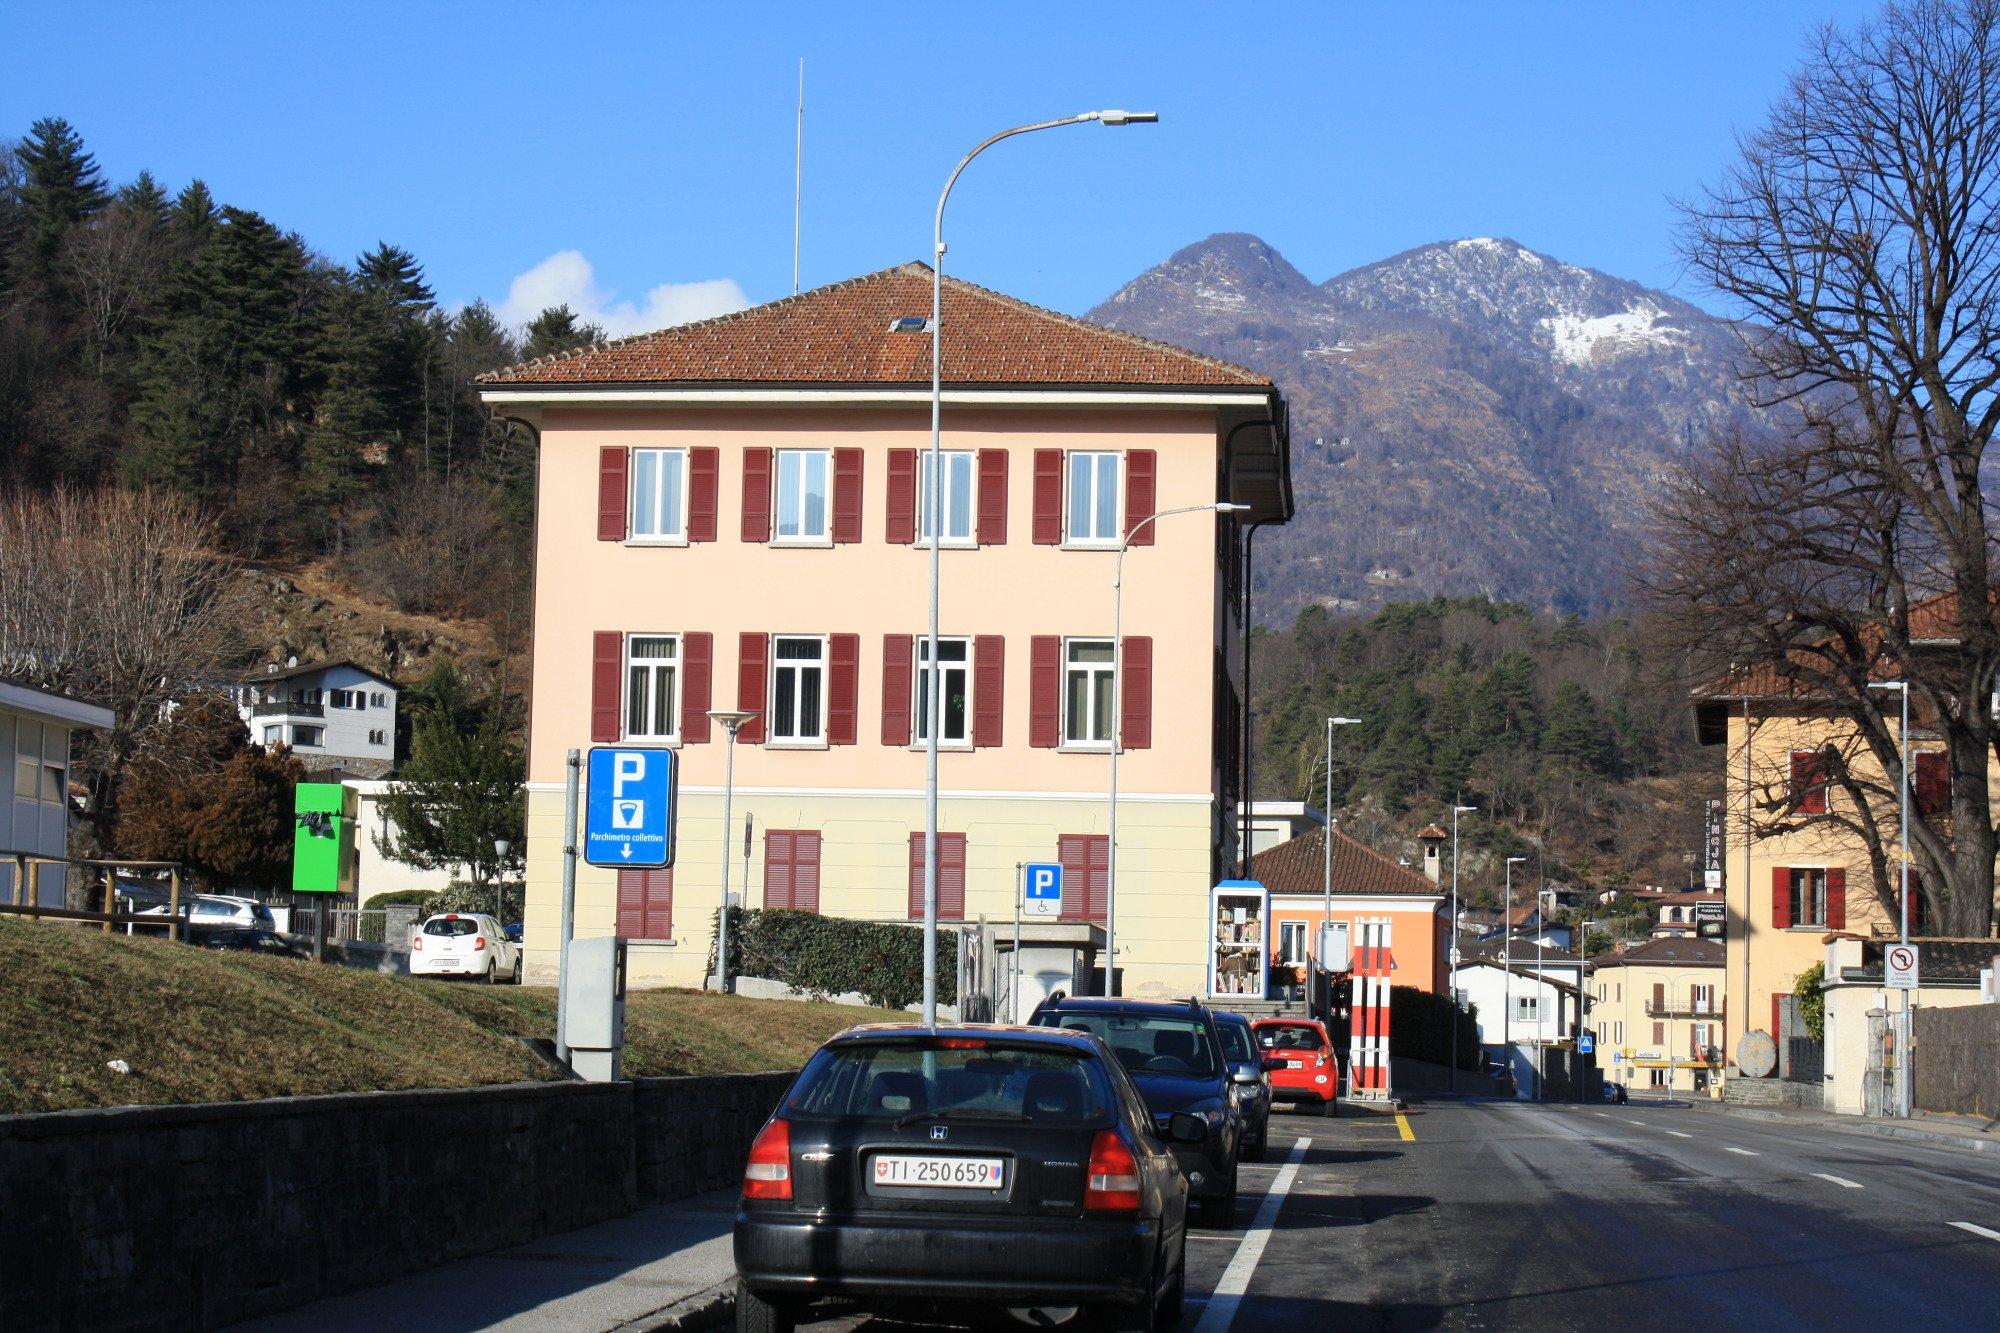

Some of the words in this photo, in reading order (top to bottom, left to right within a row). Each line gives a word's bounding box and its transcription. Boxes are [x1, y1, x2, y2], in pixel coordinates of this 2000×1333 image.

[613, 753, 646, 798] P
[591, 832, 631, 841] Parchimetro
[632, 834, 663, 842] collettivo
[1035, 869, 1053, 896] P
